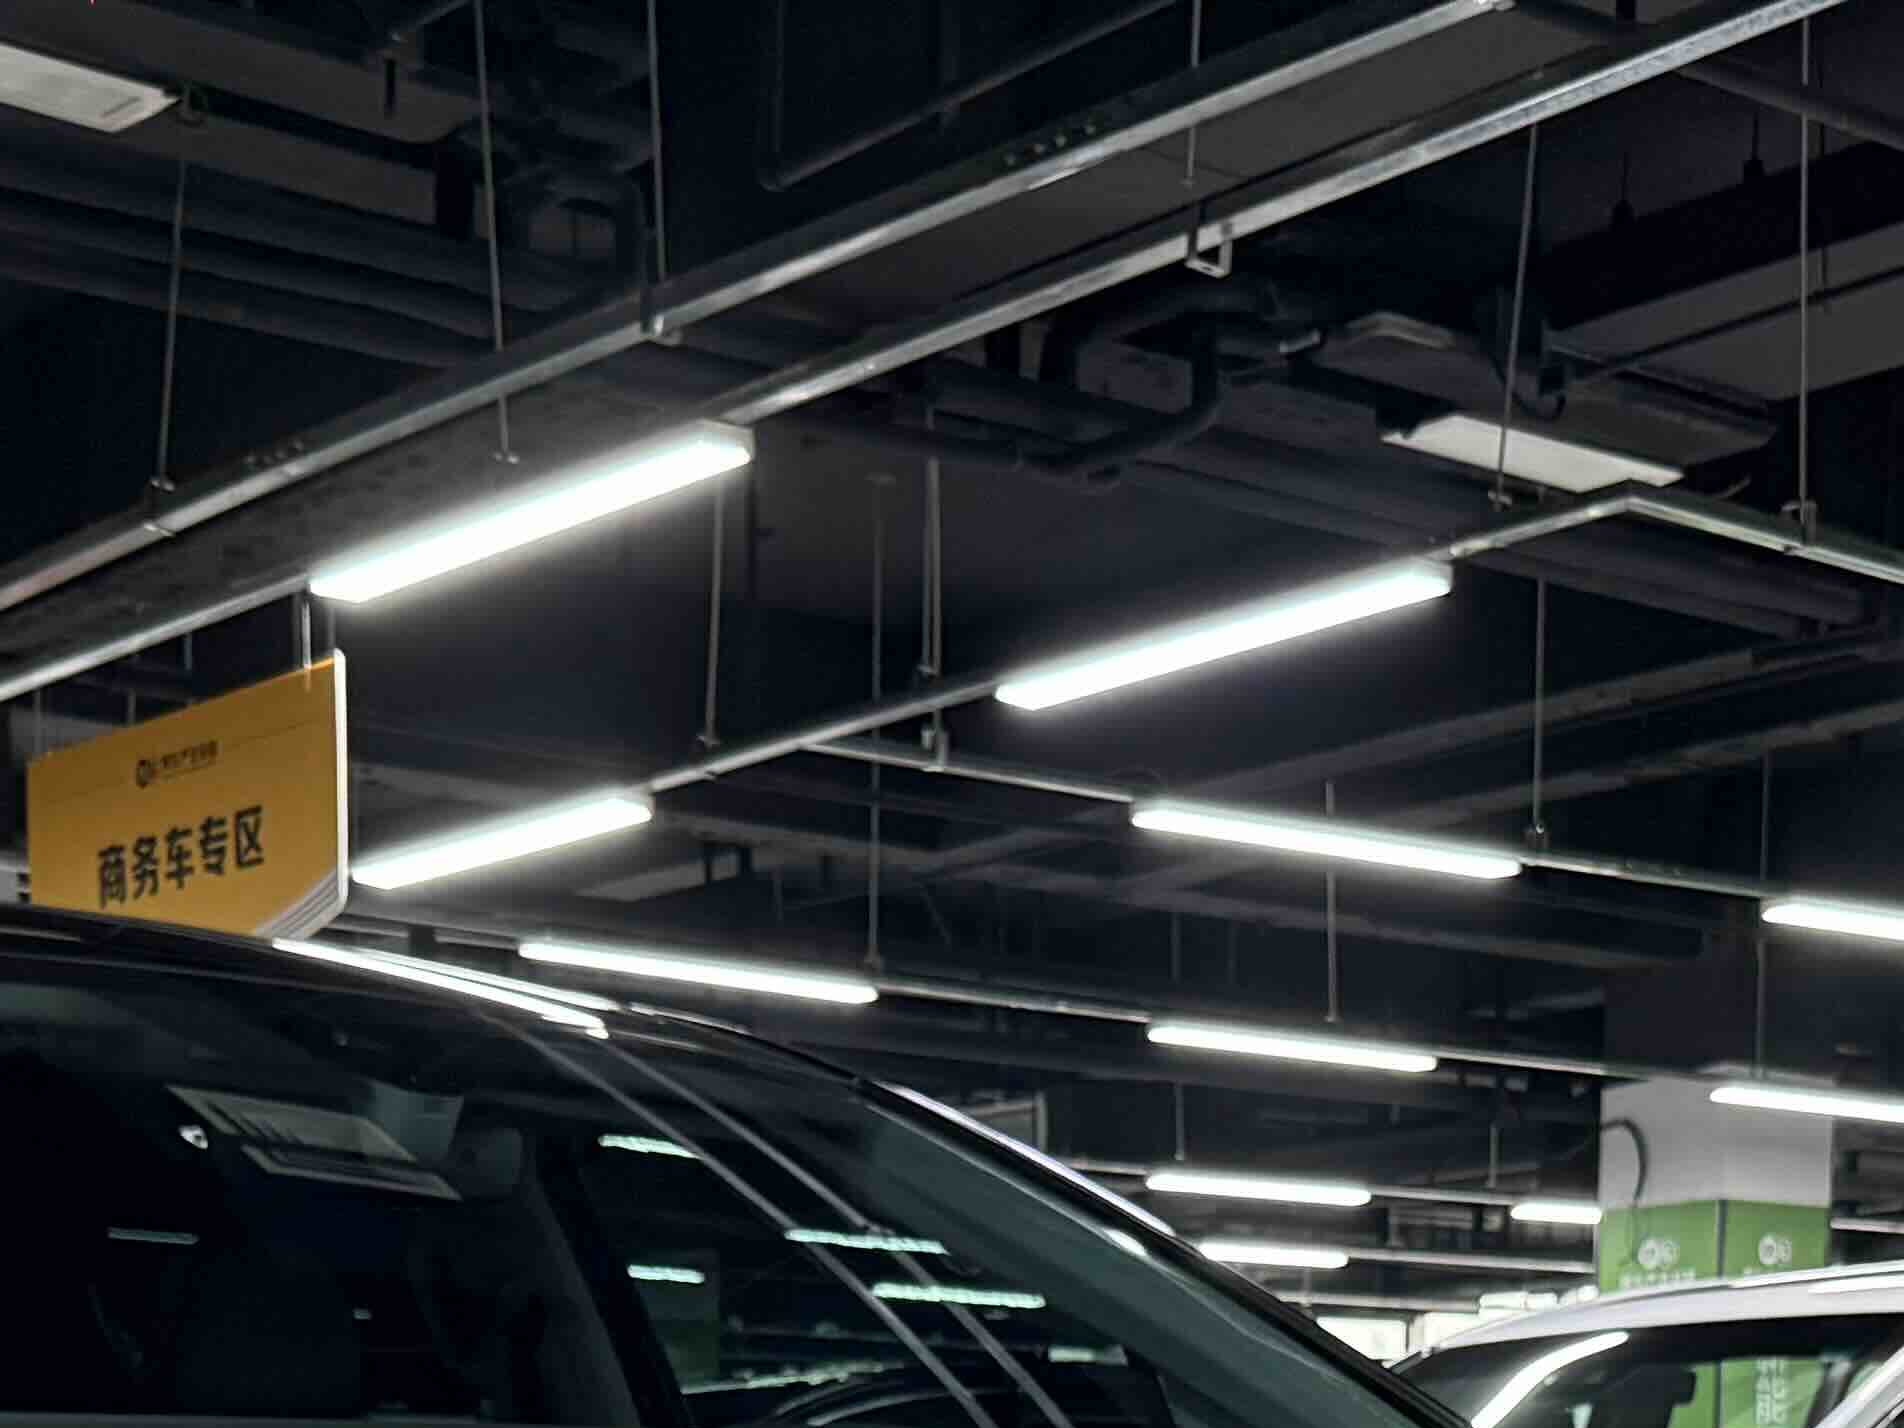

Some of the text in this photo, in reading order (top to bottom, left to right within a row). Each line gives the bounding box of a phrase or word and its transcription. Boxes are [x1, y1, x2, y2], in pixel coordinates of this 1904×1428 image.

[97, 804, 265, 910] 商务车专区
